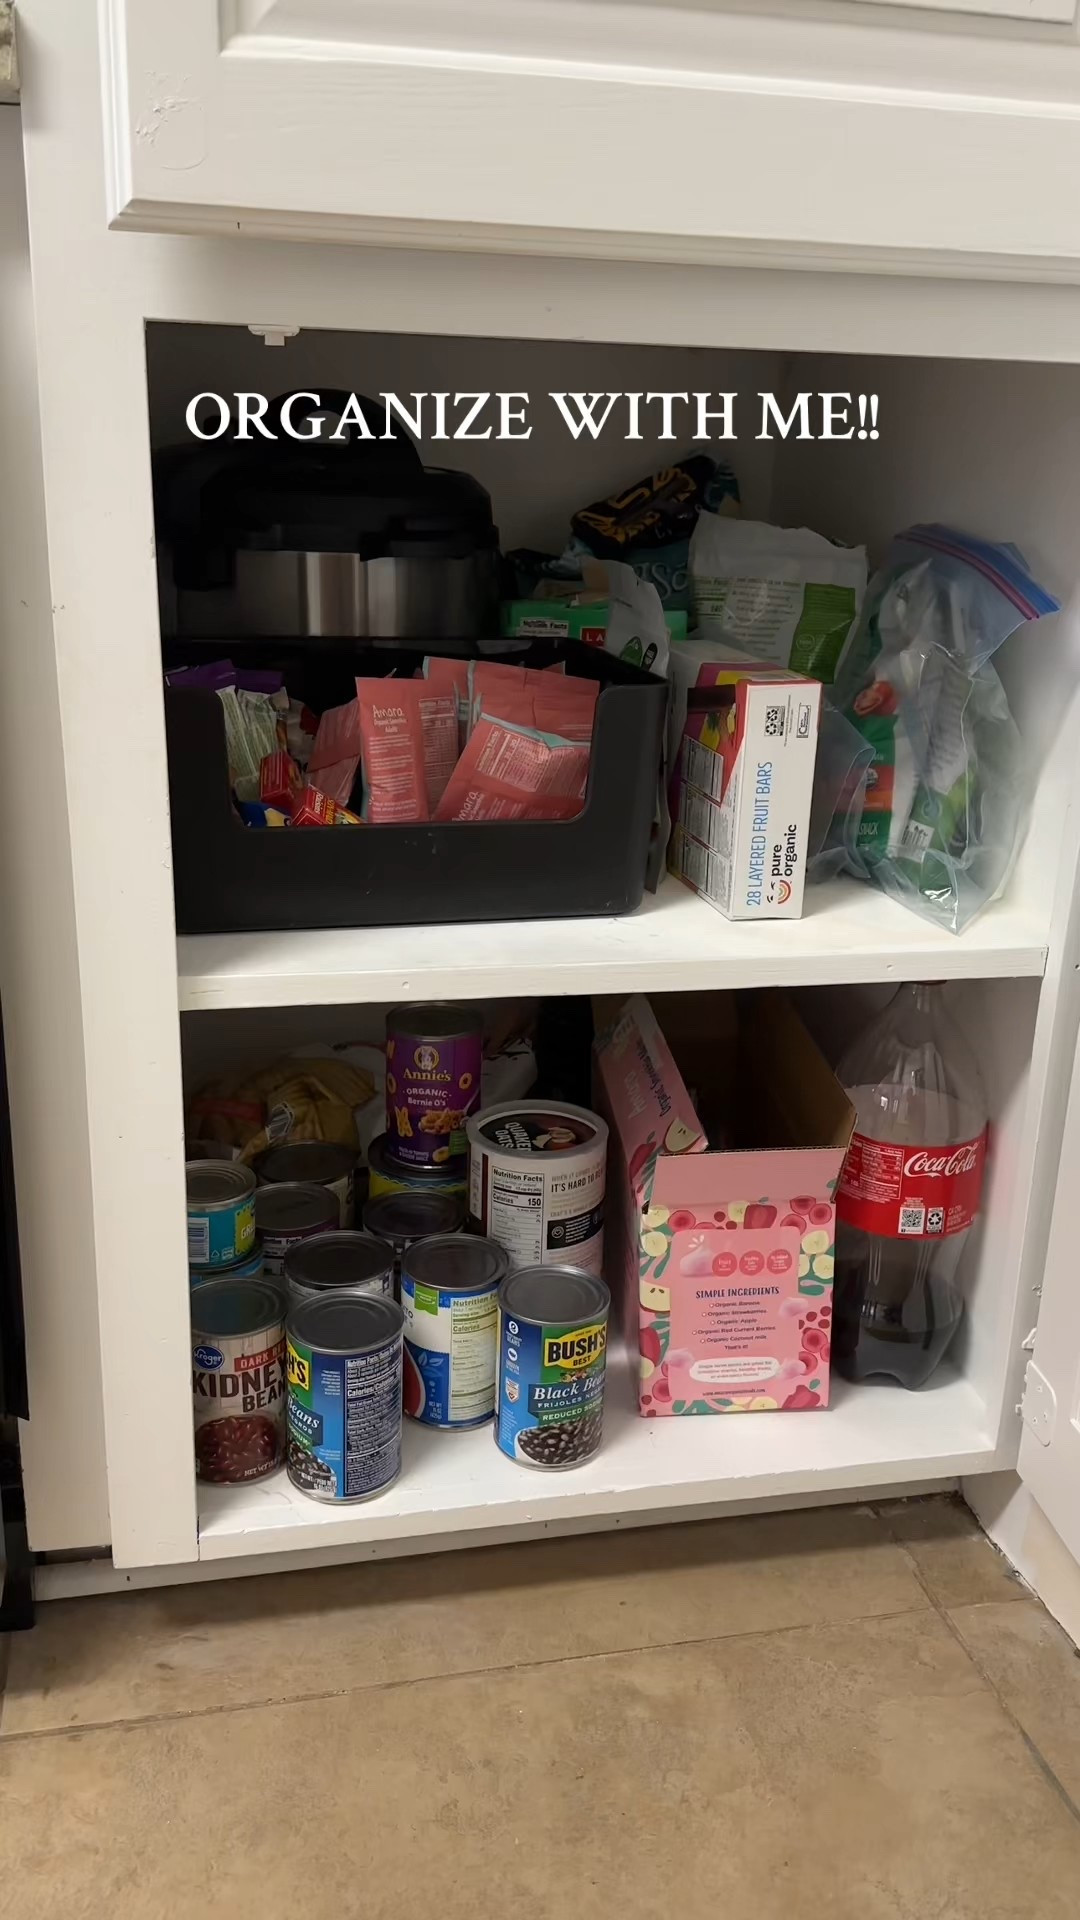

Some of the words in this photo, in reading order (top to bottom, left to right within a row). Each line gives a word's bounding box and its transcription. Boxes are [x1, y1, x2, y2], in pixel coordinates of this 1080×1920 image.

[372, 704, 403, 718] Amara
[756, 761, 773, 796] BARS
[753, 797, 770, 833] FRUIT
[783, 824, 798, 878] organic
[748, 835, 767, 889] LAYERED
[770, 844, 783, 878] pure
[746, 890, 761, 907] 28
[402, 1067, 452, 1082] Annie's
[406, 1087, 449, 1098] ORGANIC
[407, 1097, 433, 1107] Bernie
[434, 1098, 446, 1107] O's
[495, 1129, 514, 1149] OATS
[903, 1141, 980, 1178] Coca-Cola
[493, 1168, 522, 1181] Nutrition
[523, 1174, 543, 1183] Facts
[551, 1182, 566, 1193] IT'S
[567, 1177, 587, 1191] HARD
[587, 1173, 595, 1185] TO
[527, 1198, 542, 1207] 150
[695, 1289, 725, 1299] SIMPLE
[728, 1286, 780, 1297] INGREDIENTS
[452, 1296, 489, 1307] Nutrition
[452, 1323, 480, 1332] Calories
[547, 1325, 607, 1364] BUSH'S
[193, 1348, 222, 1366] Kroger
[240, 1353, 269, 1370] DARK
[572, 1354, 591, 1367] BEST
[192, 1355, 287, 1399] KIDNEY
[533, 1382, 580, 1401] Black
[537, 1396, 582, 1409] FRIJOLES
[542, 1407, 583, 1421] REDUCED
